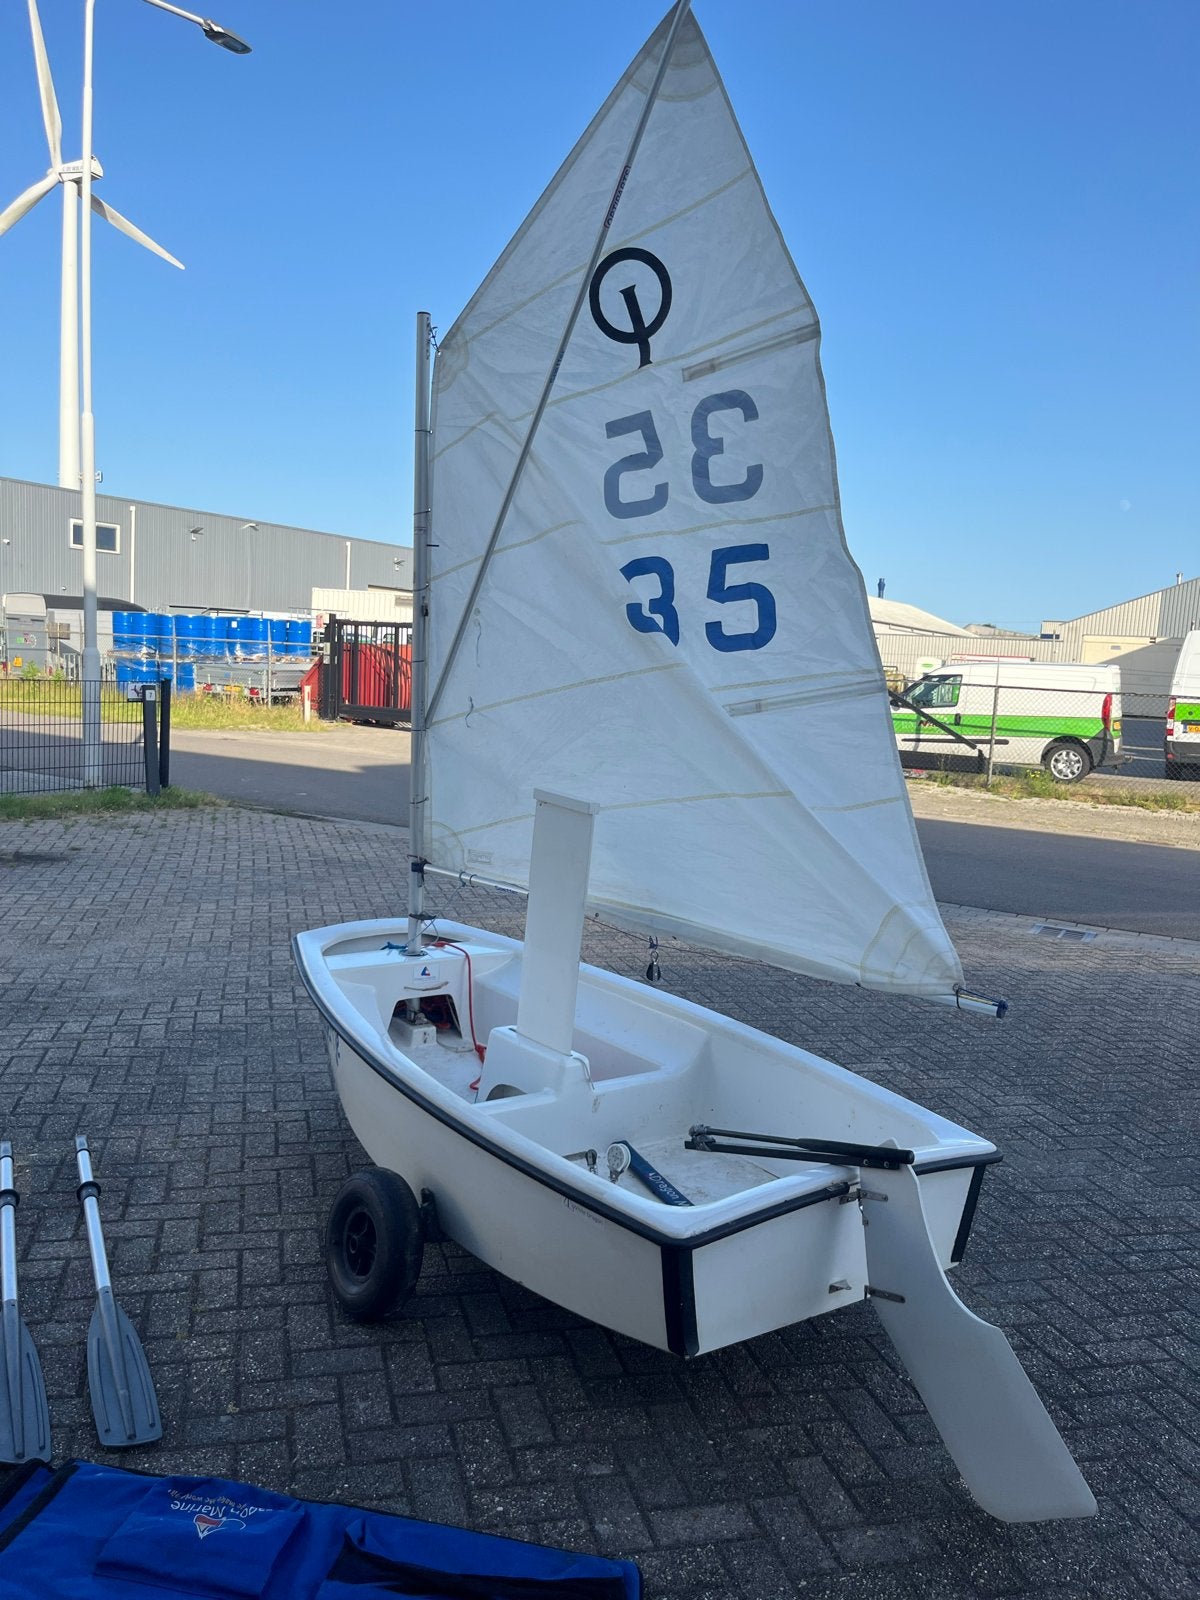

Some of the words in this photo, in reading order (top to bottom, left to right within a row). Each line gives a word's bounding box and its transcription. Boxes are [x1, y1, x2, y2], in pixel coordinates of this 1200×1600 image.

[606, 168, 631, 226] OPTIPARTS
[619, 543, 777, 652] 35
[648, 1175, 680, 1200] Dragon
[170, 1500, 226, 1518] Marine
